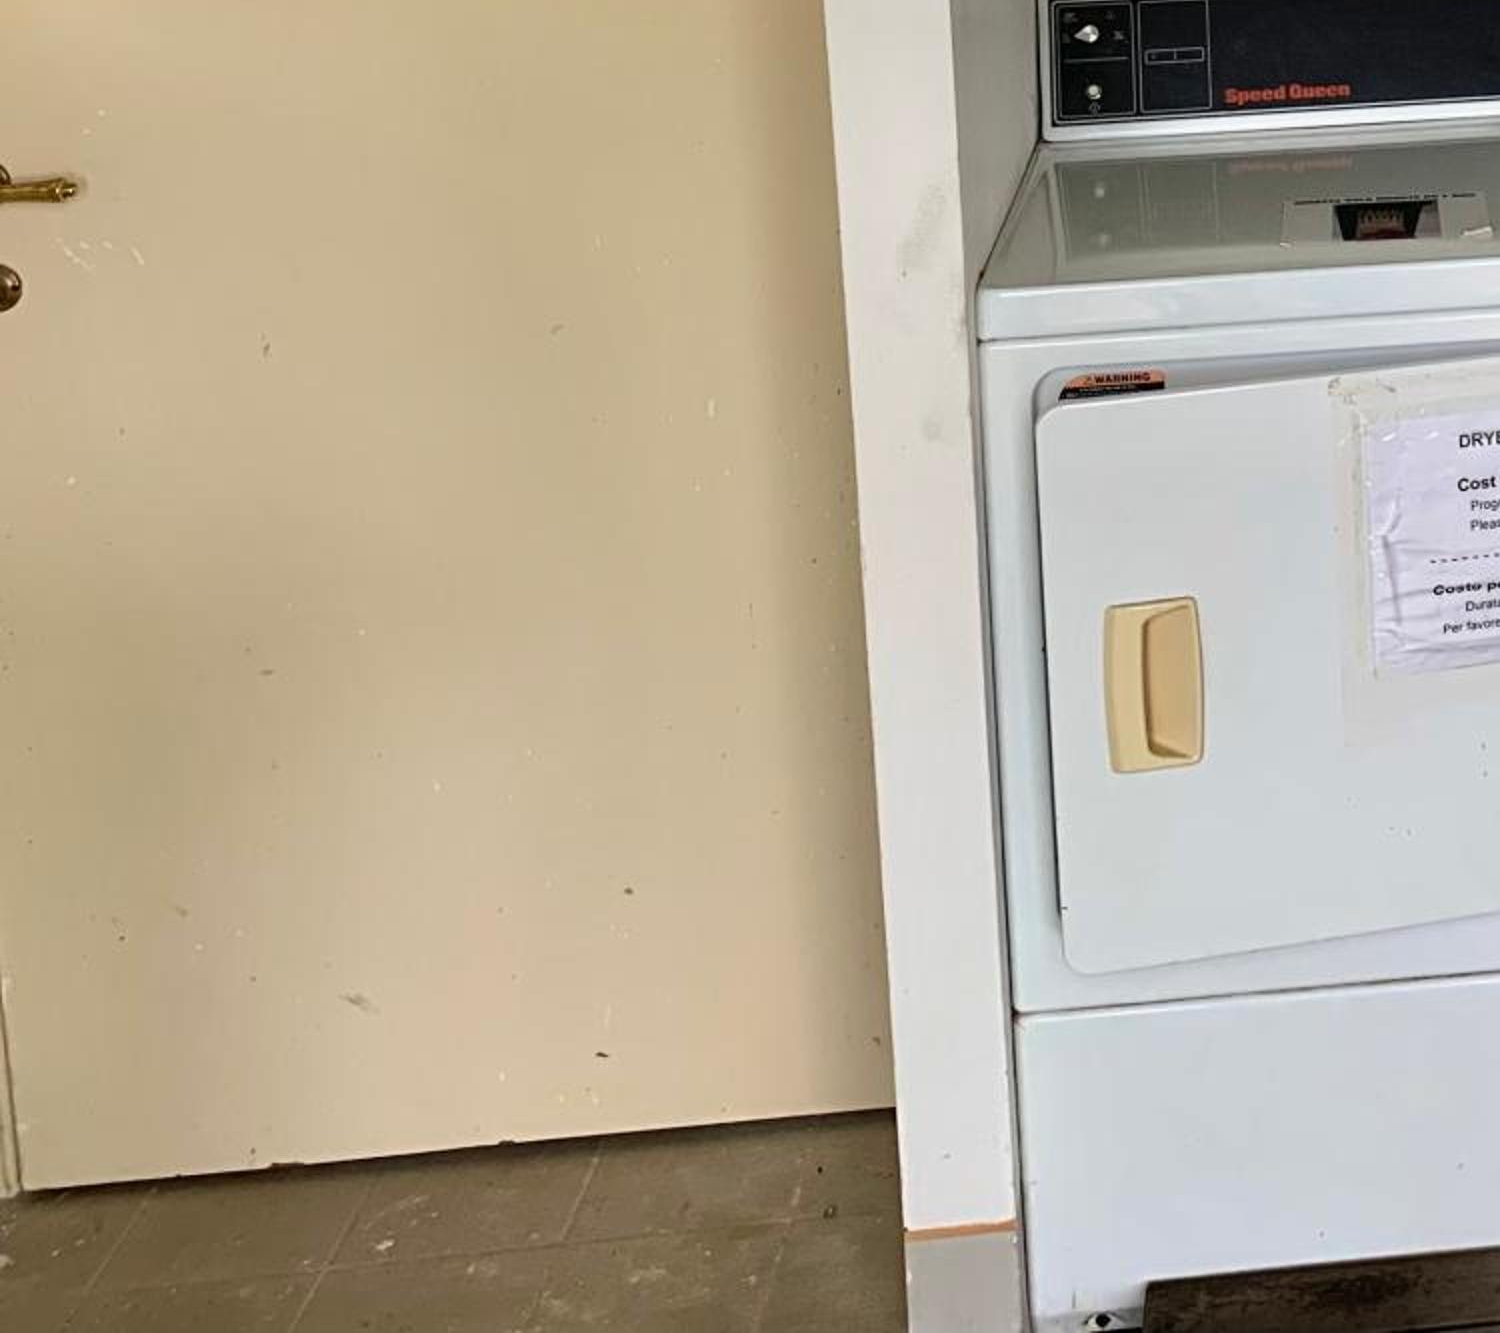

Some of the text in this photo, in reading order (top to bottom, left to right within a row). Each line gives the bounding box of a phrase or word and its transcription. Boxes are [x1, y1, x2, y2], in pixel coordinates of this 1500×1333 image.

[1224, 83, 1350, 106] Speed Queen
[1095, 371, 1151, 384] WARNING
[1457, 475, 1497, 492] Cost
[1433, 583, 1481, 596] Costo
[1443, 622, 1463, 634] Per
